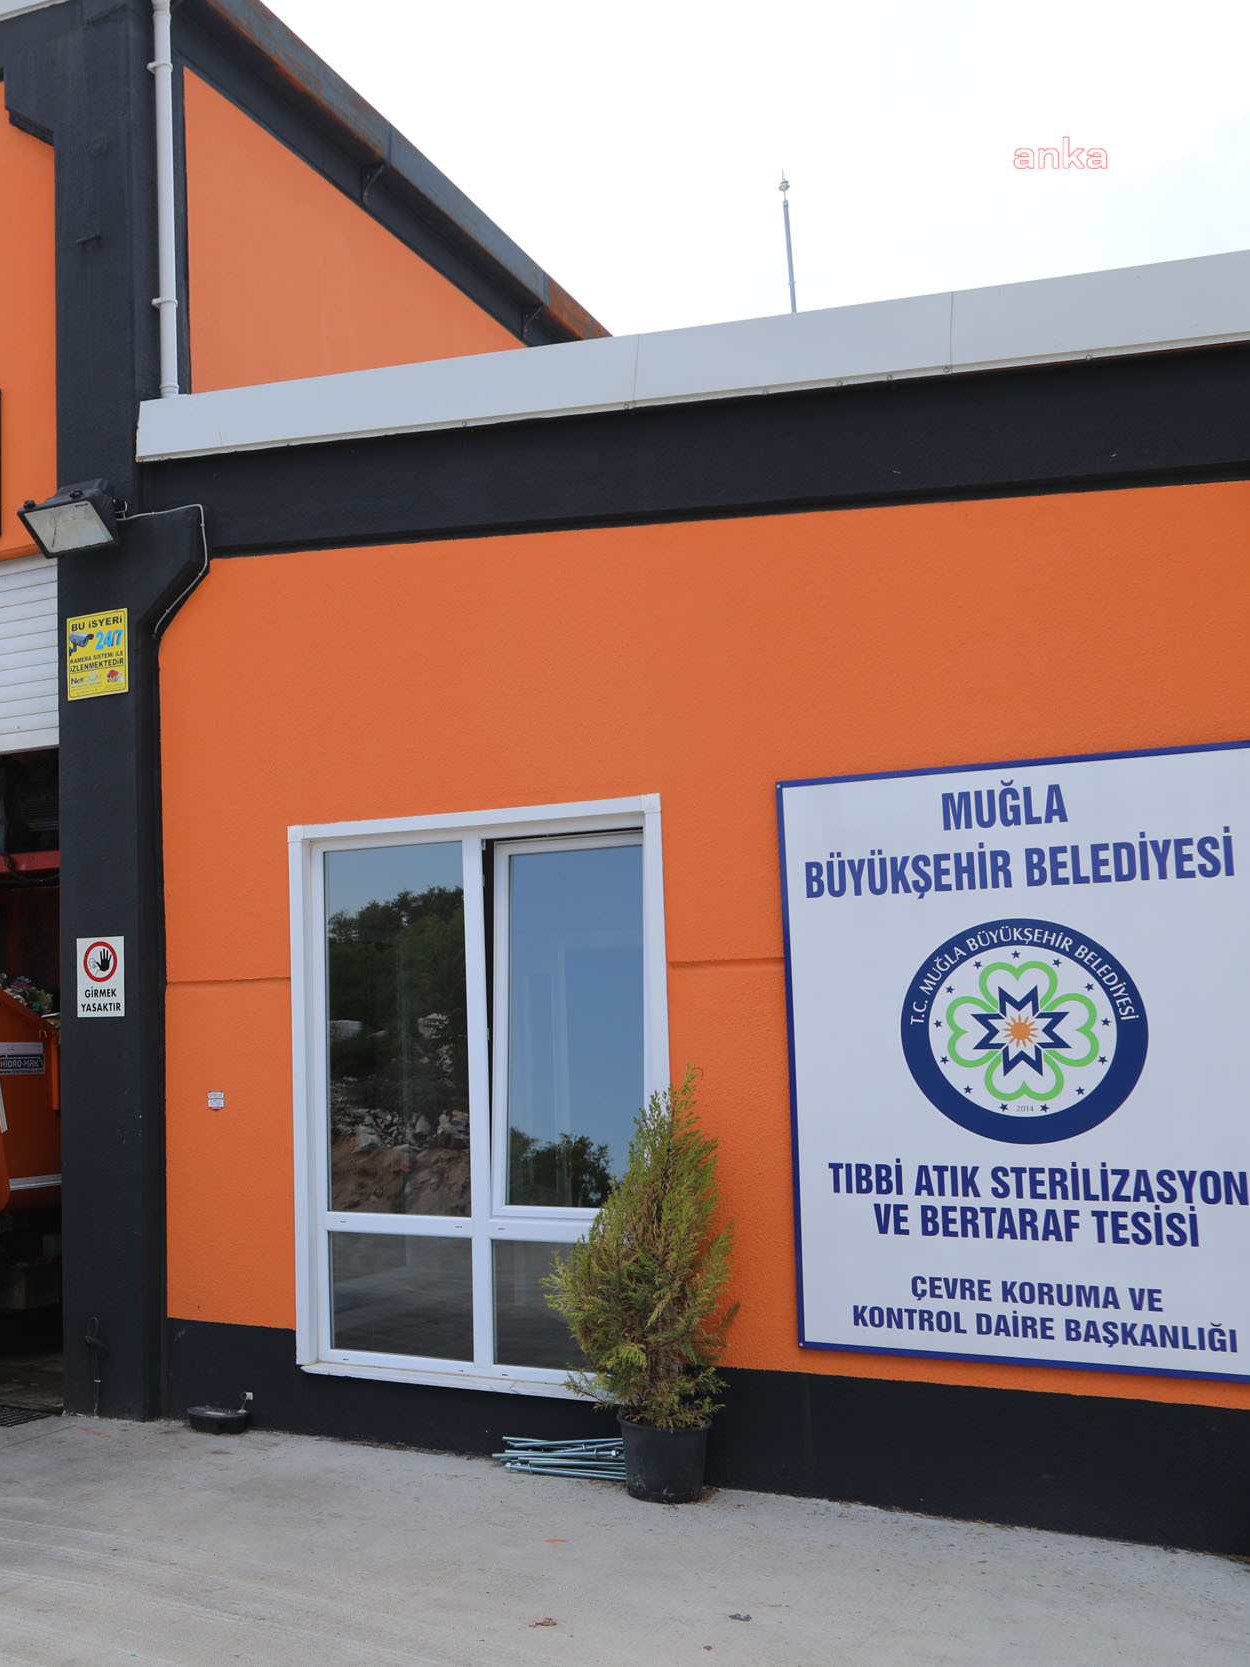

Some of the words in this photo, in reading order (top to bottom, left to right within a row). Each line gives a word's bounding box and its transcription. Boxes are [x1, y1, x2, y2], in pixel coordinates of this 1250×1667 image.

[71, 622, 85, 631] BU
[70, 655, 91, 664] KAMERA
[941, 779, 1069, 831] MUĞLA
[805, 842, 1013, 899] BÜYÜKŞEHİR
[1024, 826, 1235, 887] BELEDİYESİ
[965, 925, 1073, 952] BÜYÜKŞEHİR
[919, 947, 967, 996] MUĞLA
[1074, 944, 1140, 1021] BELEDİYESİ
[81, 1002, 121, 1012] YASAKTIR
[84, 986, 117, 998] GİRMEK
[910, 999, 929, 1025] T.C.
[1016, 1105, 1034, 1113] 2014
[828, 1158, 904, 1196] TIBBİ
[914, 1164, 981, 1198] ATIK
[990, 1161, 1250, 1206] STERİLİZASYON
[873, 1203, 910, 1236] VE
[920, 1204, 1080, 1242] BERTARAF
[1091, 1204, 1200, 1247] TESİSİ
[910, 1275, 992, 1302] ÇEVRE
[1001, 1280, 1121, 1310] KORUMA
[1128, 1287, 1164, 1312] VE
[852, 1304, 967, 1334] KONTROL
[975, 1310, 1055, 1341] DAİRE
[1065, 1318, 1238, 1354] BAŞKANLIĞI
